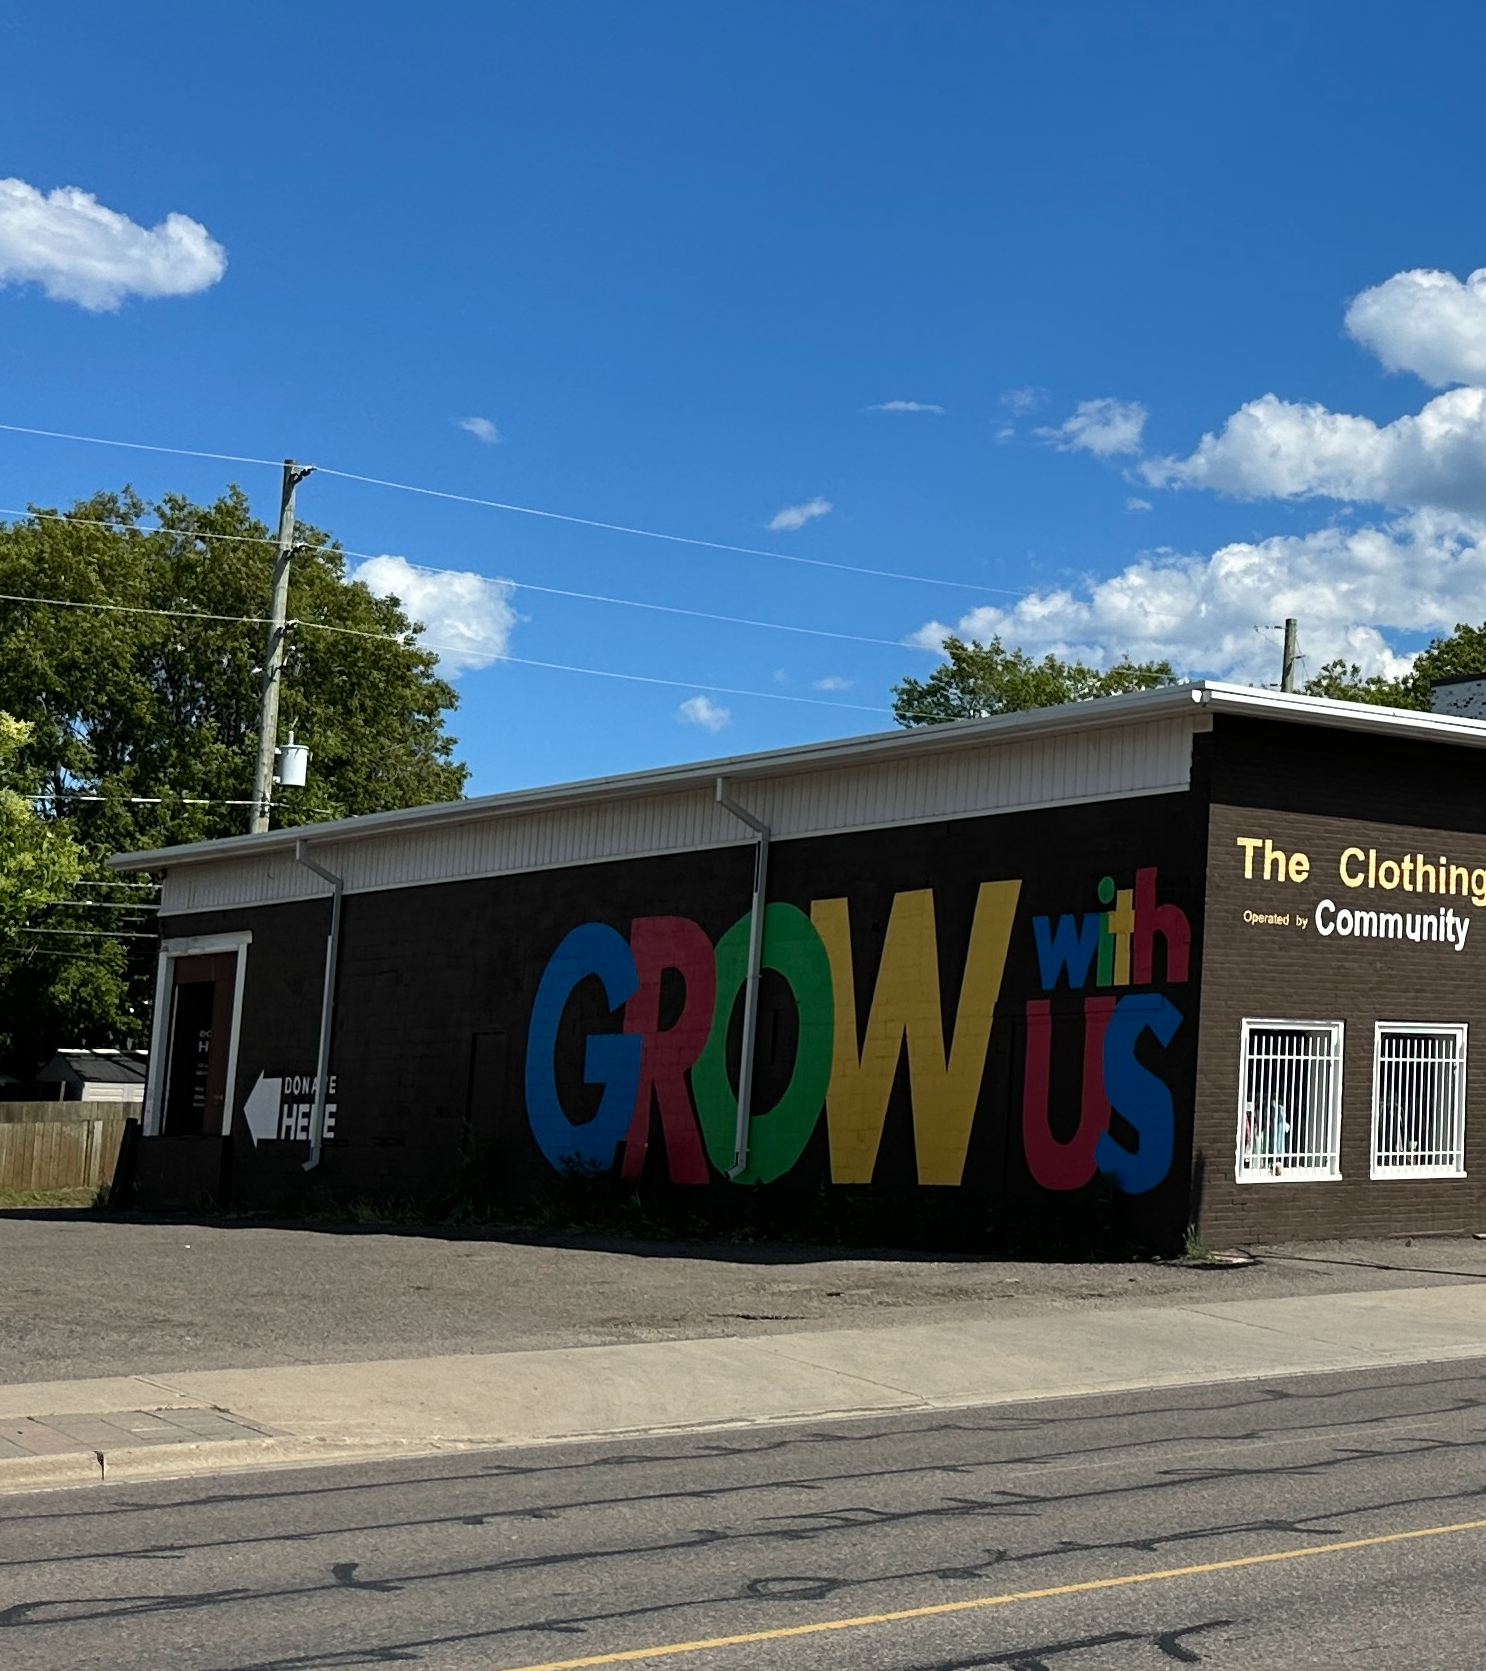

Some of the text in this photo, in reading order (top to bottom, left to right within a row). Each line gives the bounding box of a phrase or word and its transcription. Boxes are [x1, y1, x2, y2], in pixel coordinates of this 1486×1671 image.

[1237, 837, 1310, 883] The
[1032, 867, 1191, 989] with
[1243, 910, 1290, 926] Operated
[1296, 915, 1309, 930] by
[1315, 899, 1470, 951] Community
[525, 879, 1022, 1186] GROW
[284, 1075, 337, 1095] DONAE
[1022, 993, 1184, 1194] US
[281, 1103, 337, 1140] HEE
